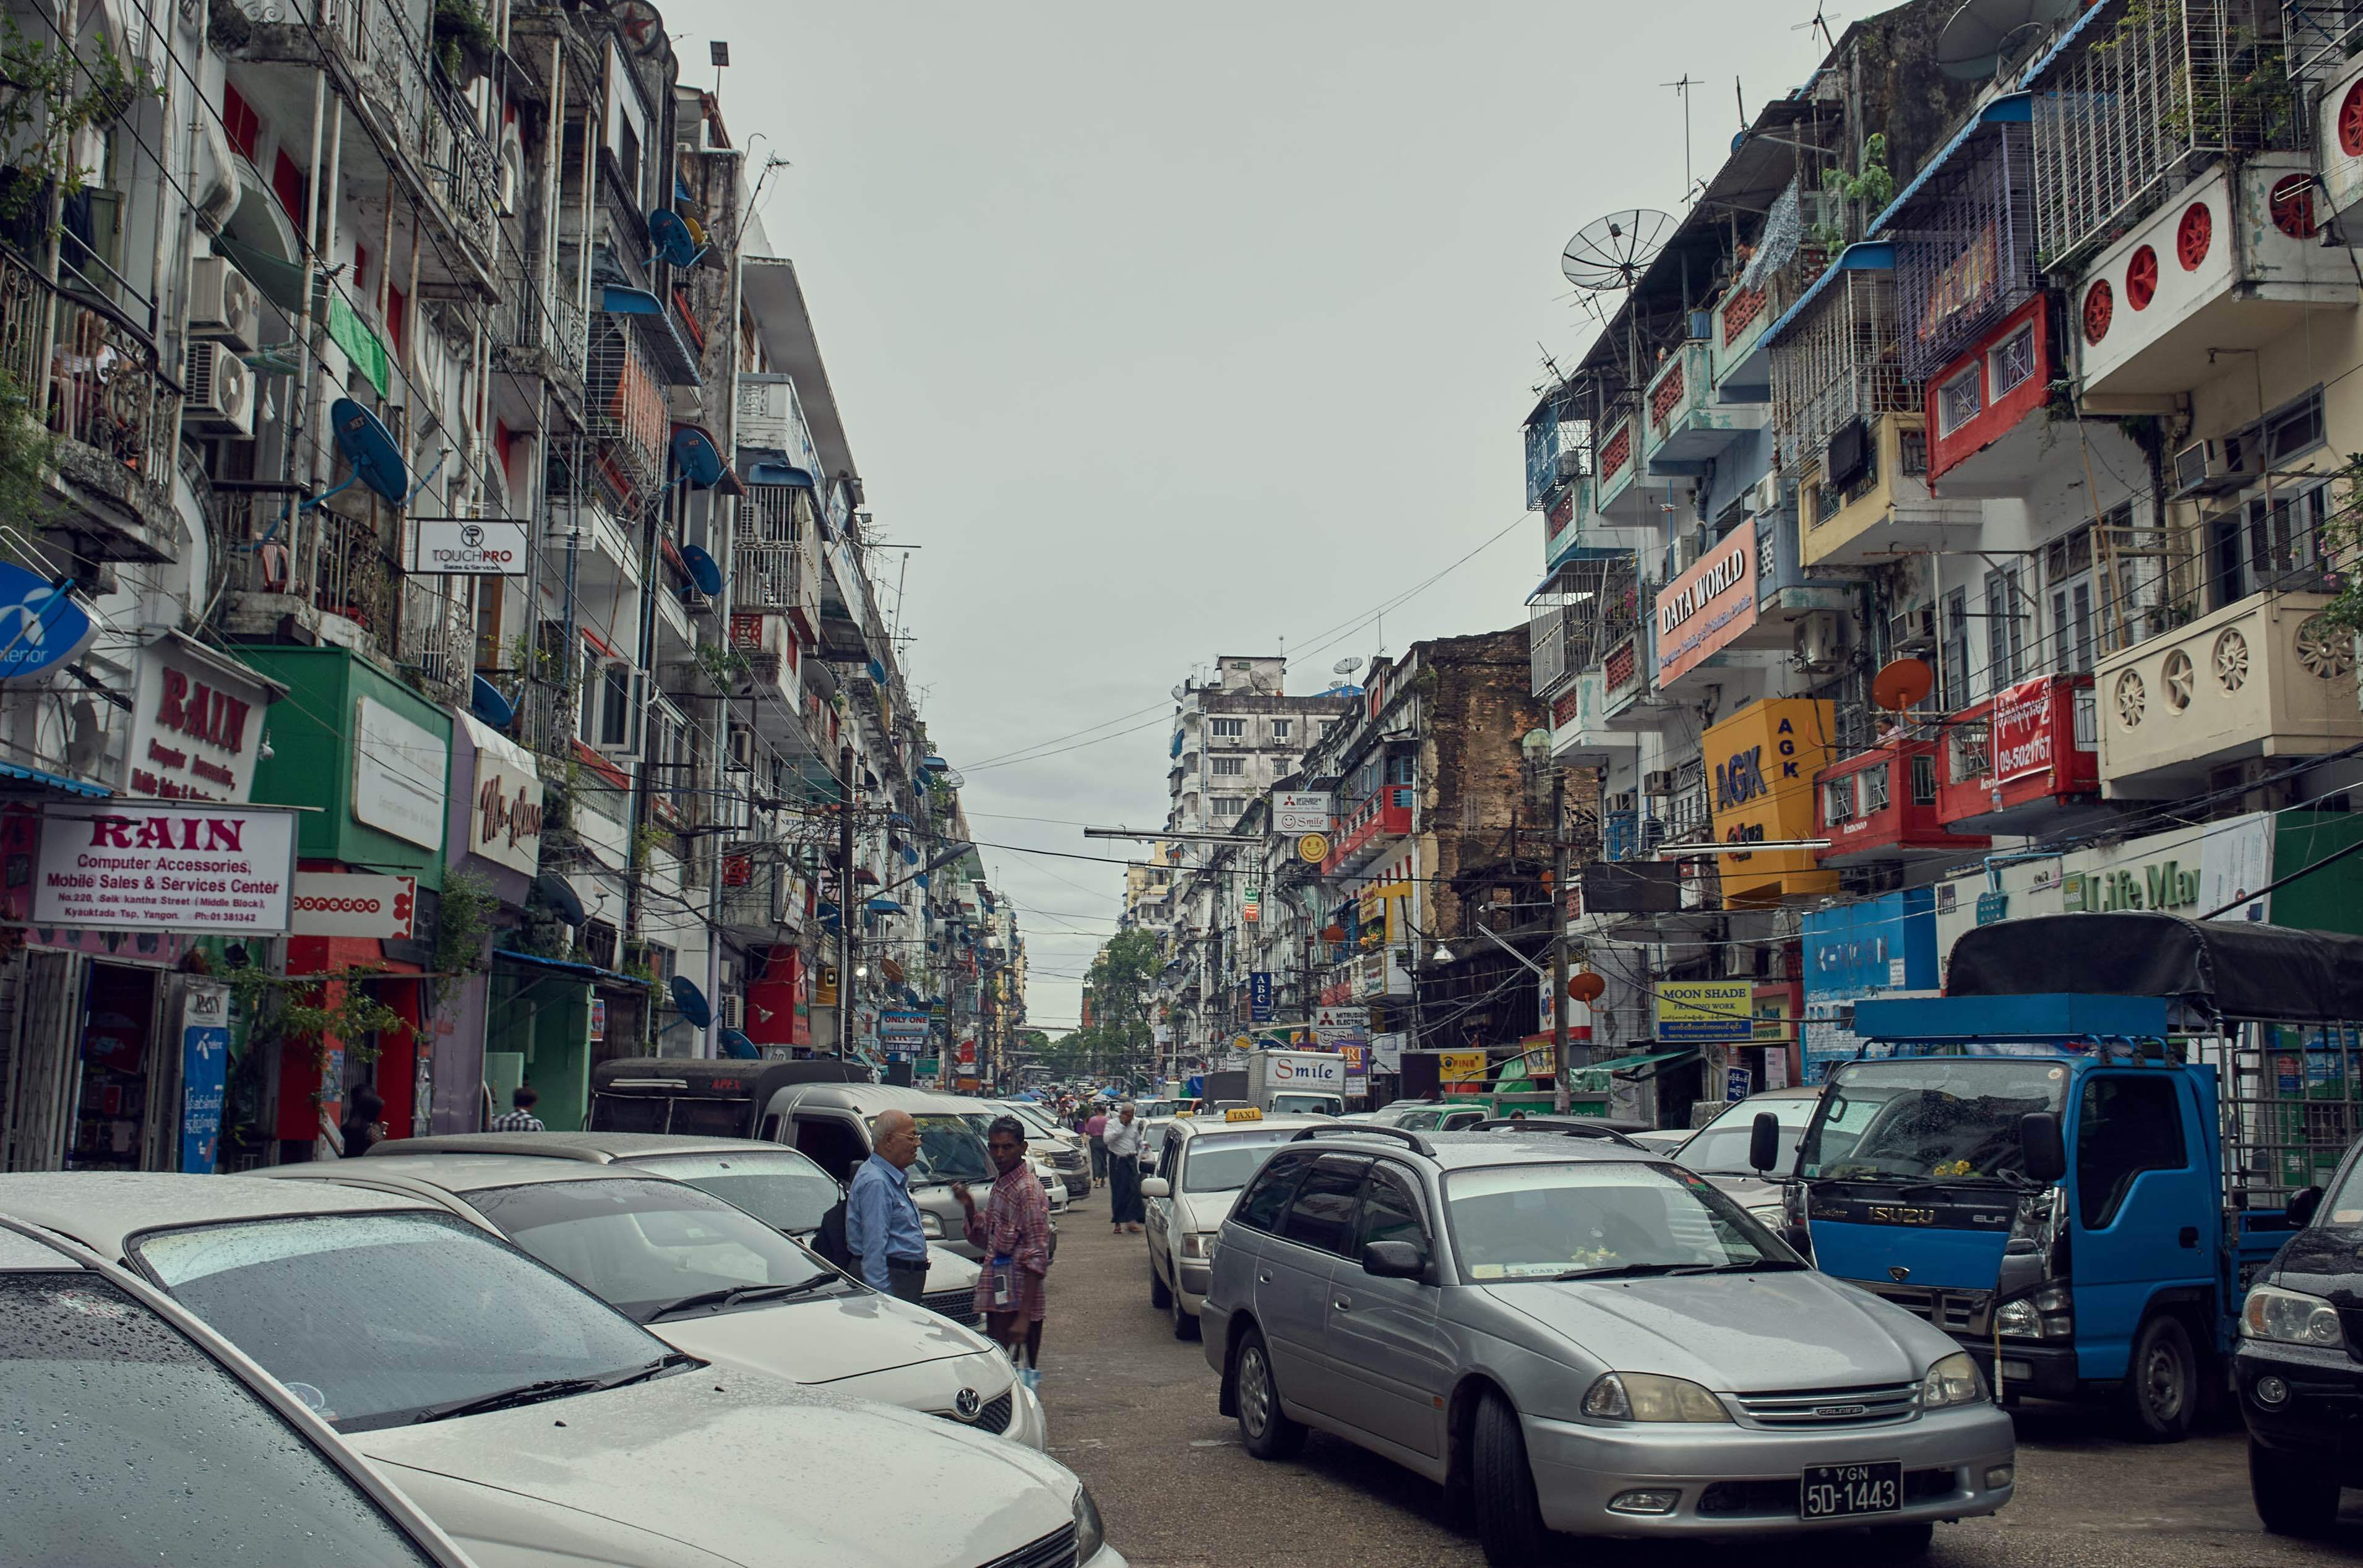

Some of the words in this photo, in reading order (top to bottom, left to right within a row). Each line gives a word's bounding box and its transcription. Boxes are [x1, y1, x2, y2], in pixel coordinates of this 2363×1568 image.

[433, 549, 512, 562] TOUCHPRO
[1662, 587, 1694, 635] DATA
[1695, 548, 1744, 609] WORLD
[156, 666, 251, 756] RAIN
[1778, 718, 1799, 778] AGK
[1999, 735, 2051, 772] 09-5021767
[1716, 745, 1767, 812] AGK
[1981, 778, 1995, 791] len
[1297, 817, 1324, 827] Smile
[1843, 821, 1867, 834] lenovo
[89, 814, 246, 852] RAIN
[77, 854, 150, 872] Computer
[156, 856, 252, 874] Accessories,
[47, 873, 94, 889] Mobile
[100, 875, 139, 890] Sales
[145, 877, 155, 890] &
[161, 877, 226, 893] Services
[231, 879, 279, 895] Center
[2086, 868, 2143, 911] Life
[2145, 861, 2202, 910] Mar
[124, 895, 157, 905] kantha
[161, 896, 190, 906] Street
[64, 907, 116, 920] Kyauktada
[1663, 989, 1701, 999] MOON
[1705, 988, 1746, 998] SHADE
[1336, 1047, 1365, 1061] ART
[1275, 1058, 1333, 1080] Smile
[711, 1079, 740, 1090] APEX
[1233, 1111, 1255, 1119] TAXI
[1869, 1206, 1935, 1224] ISUZU
[1972, 1214, 2007, 1223] ELF
[1836, 1466, 1868, 1481] YGN
[1808, 1480, 1895, 1514] 5D-1443
